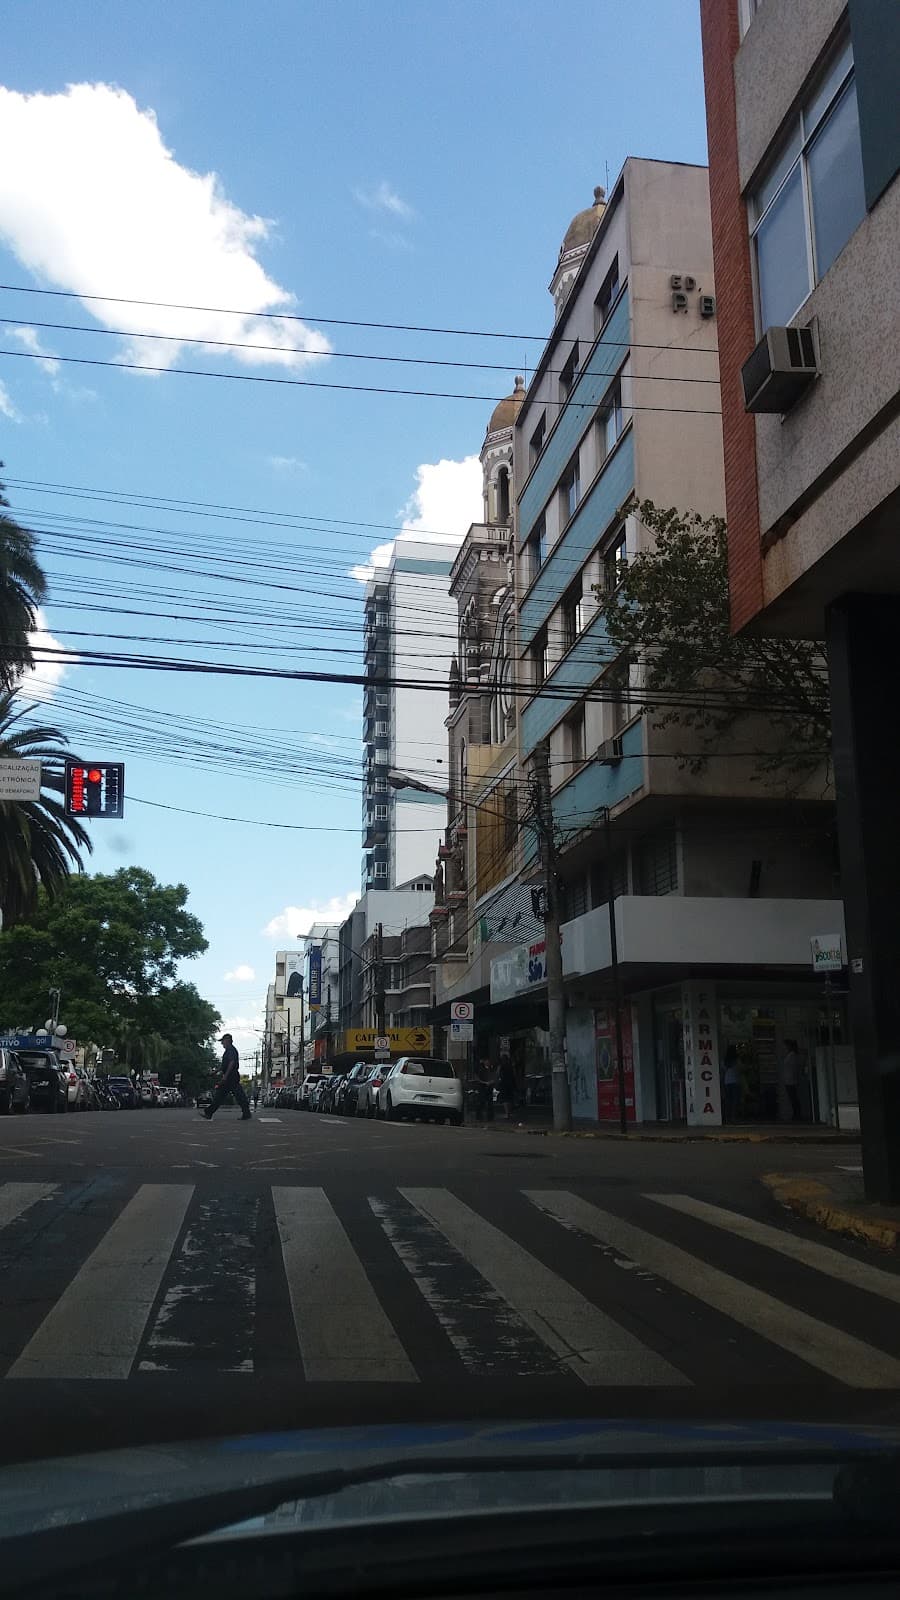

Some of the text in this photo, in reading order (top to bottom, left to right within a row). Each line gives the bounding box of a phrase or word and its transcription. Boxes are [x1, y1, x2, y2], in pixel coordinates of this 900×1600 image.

[459, 1006, 466, 1016] E
[355, 1033, 401, 1042] CATEAL
[0, 1039, 20, 1047] TIVO
[698, 993, 714, 1113] FARMÁCIA
